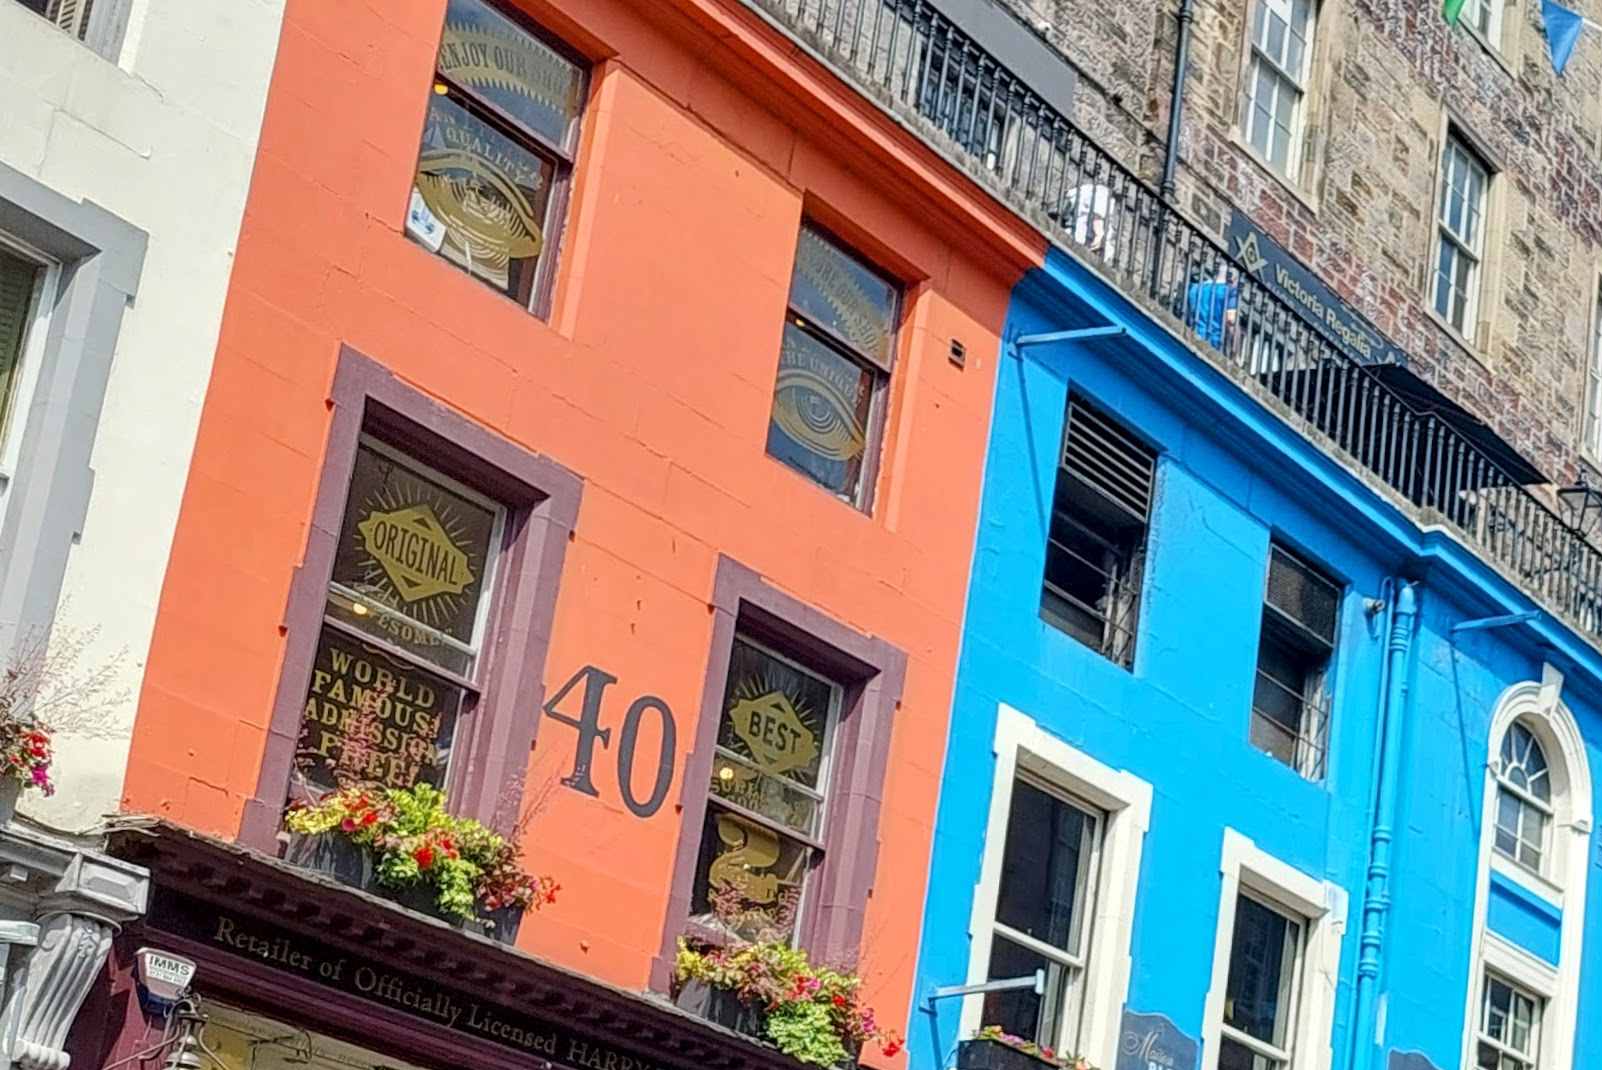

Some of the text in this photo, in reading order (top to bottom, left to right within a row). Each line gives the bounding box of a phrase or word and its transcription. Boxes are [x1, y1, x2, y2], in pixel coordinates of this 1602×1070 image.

[1275, 263, 1325, 318] Victoria
[1326, 308, 1372, 358] Regalia
[374, 520, 458, 585] ORIGINAL
[330, 646, 435, 709] WORLD
[543, 665, 677, 819] 40
[750, 711, 800, 754] BEST
[150, 955, 190, 976] IMMS
[214, 916, 313, 970] Retailer
[320, 959, 345, 988] of
[355, 967, 464, 1027] Officially
[466, 1005, 557, 1055] Licensed
